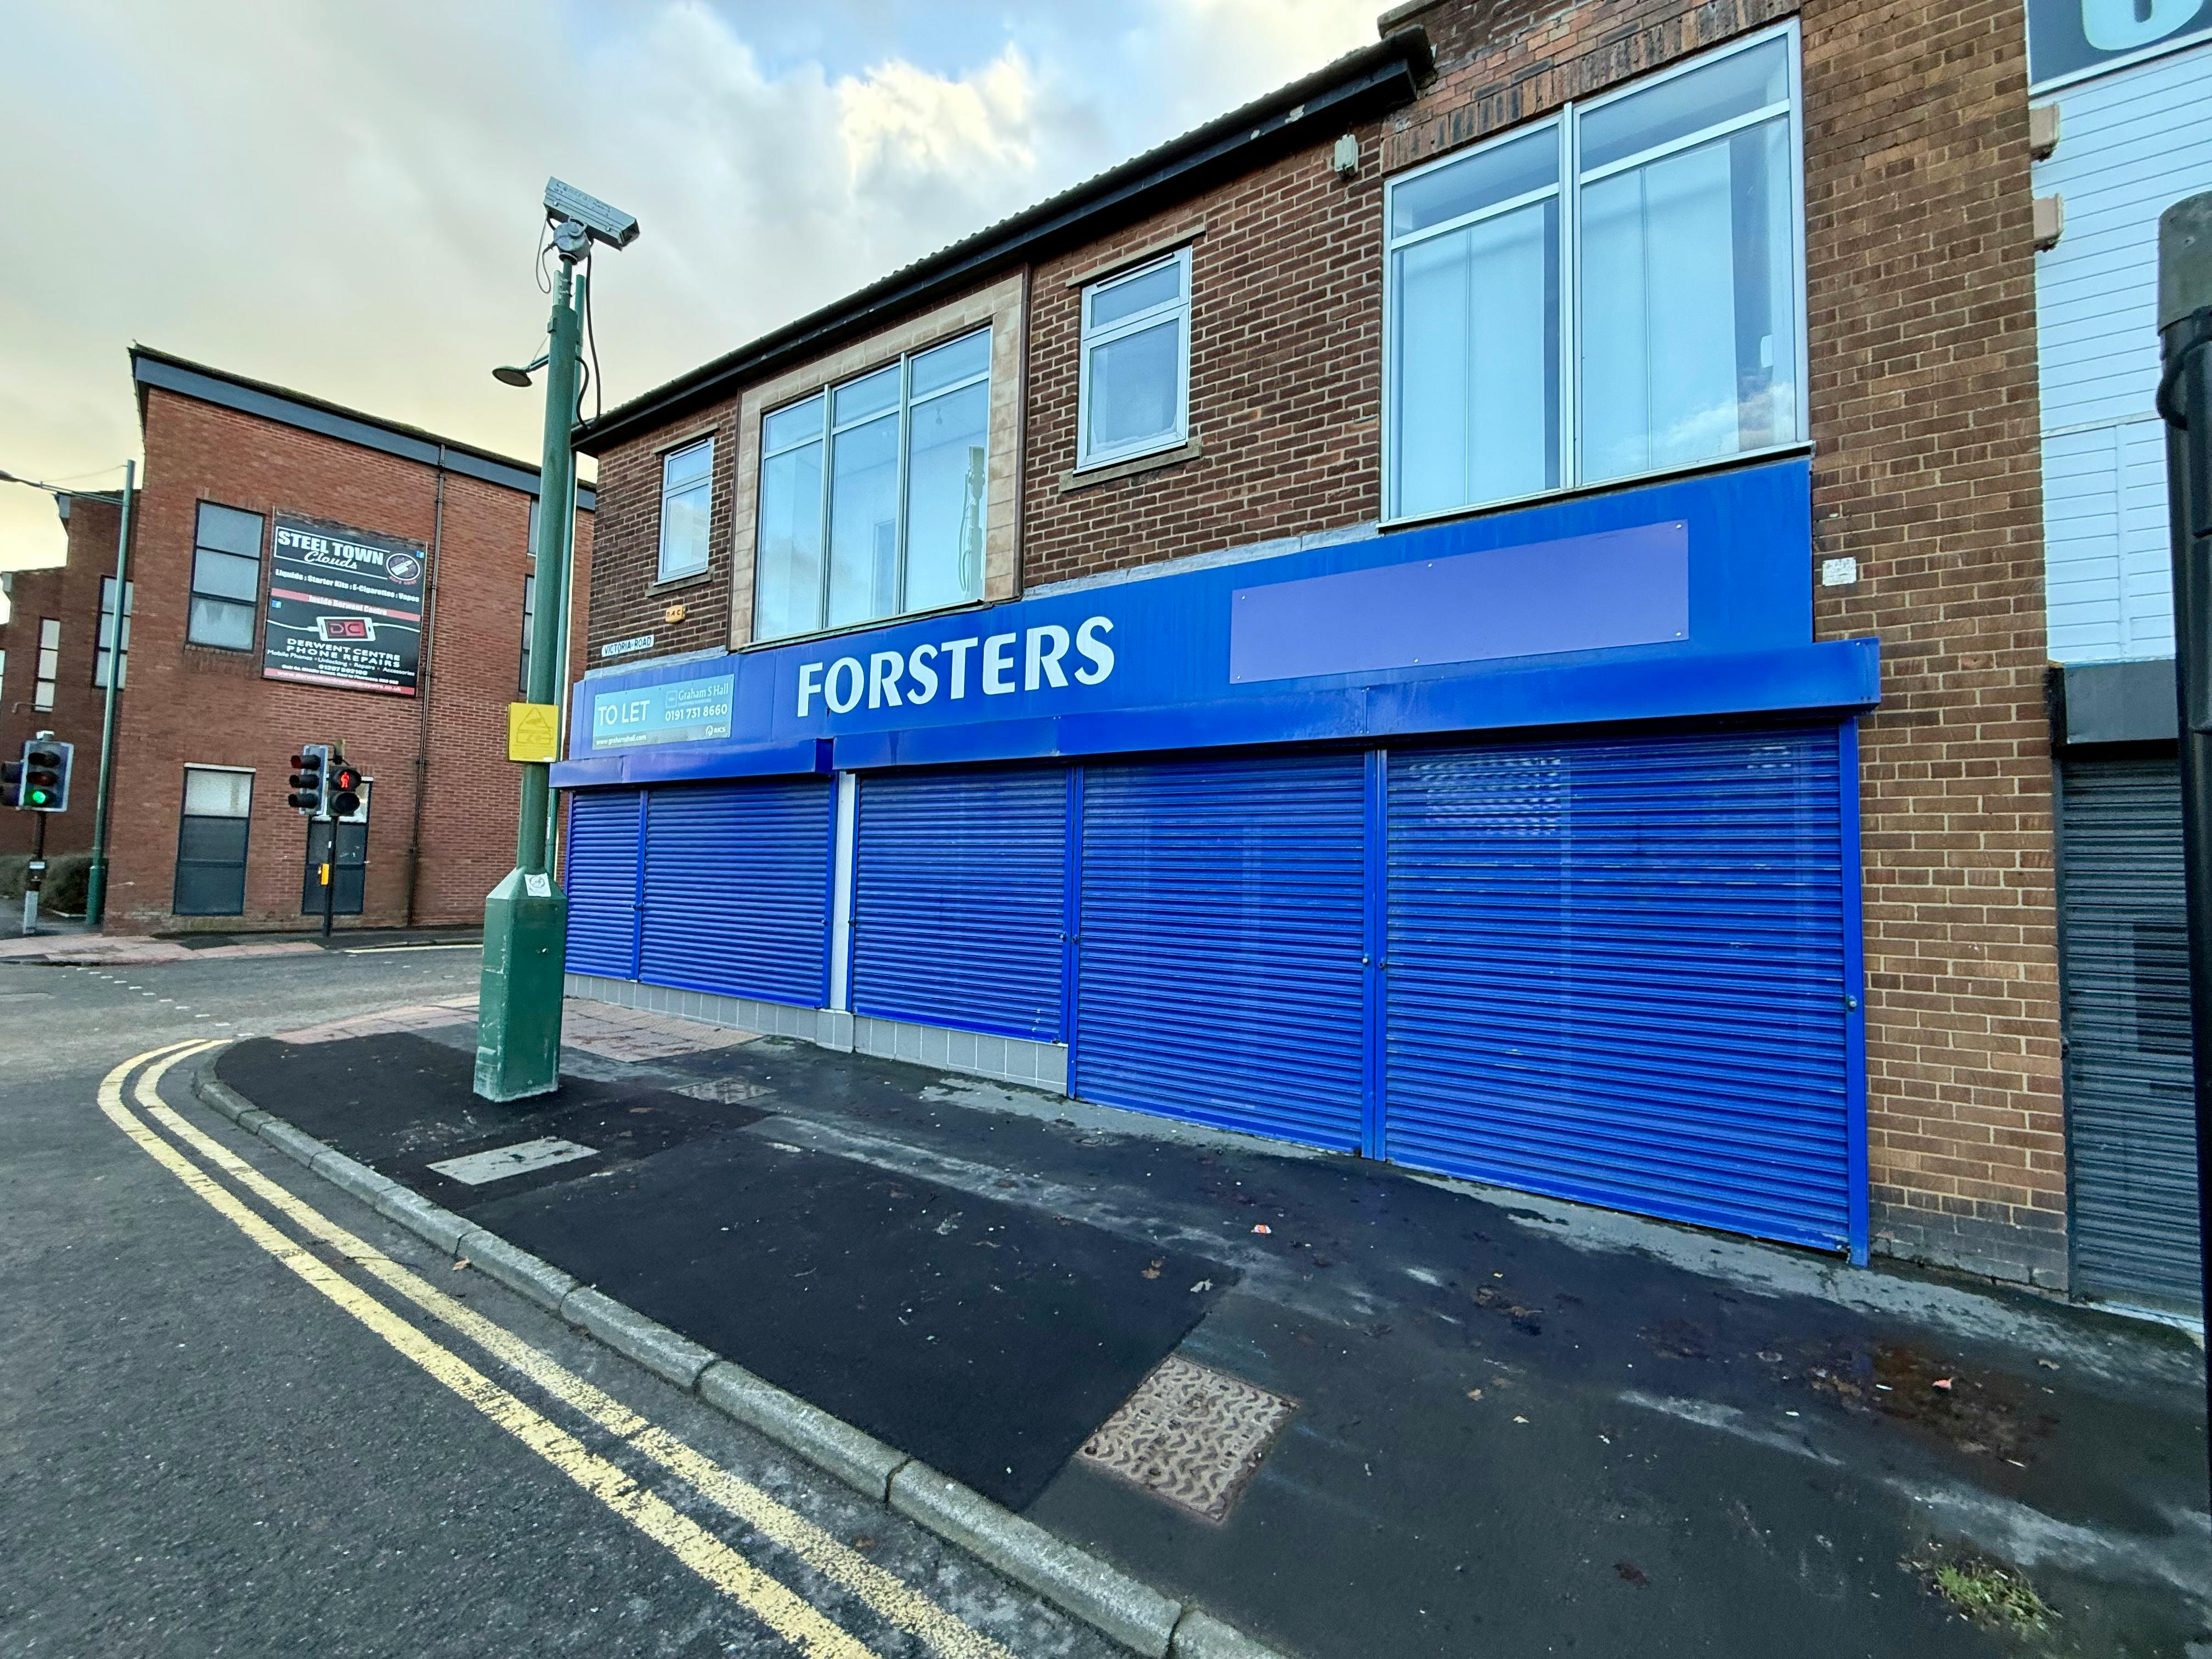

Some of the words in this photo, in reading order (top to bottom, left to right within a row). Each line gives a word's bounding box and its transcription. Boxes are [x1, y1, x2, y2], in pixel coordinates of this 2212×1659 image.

[278, 531, 329, 554] STEEL
[332, 542, 383, 566] TOWN
[304, 551, 357, 569] Clouds
[275, 568, 303, 580] Liquids
[307, 575, 334, 586] Starter
[335, 580, 349, 589] Kits
[353, 584, 395, 597] E-Cigarettes
[399, 592, 419, 602] Vapes
[286, 645, 338, 658] PHONE
[343, 653, 400, 668] REPAIRS
[287, 638, 351, 653] DERWENT
[353, 648, 400, 661] CENTRE
[605, 641, 631, 654] VICTORIA
[635, 637, 651, 648] ROAD
[267, 649, 289, 657] Mobile
[290, 652, 313, 661] Phones
[318, 657, 348, 667] Unlocking
[383, 667, 415, 676] Accessories
[797, 616, 1115, 717] FORSTERS
[679, 688, 706, 701] Graham
[707, 686, 712, 697] S
[713, 682, 729, 696] Hall
[598, 705, 618, 726] TO
[622, 700, 650, 723] LET
[665, 709, 684, 721] 0191
[686, 707, 701, 719] 731
[703, 704, 727, 717] 8660
[596, 735, 646, 745] www.grahamshall.com
